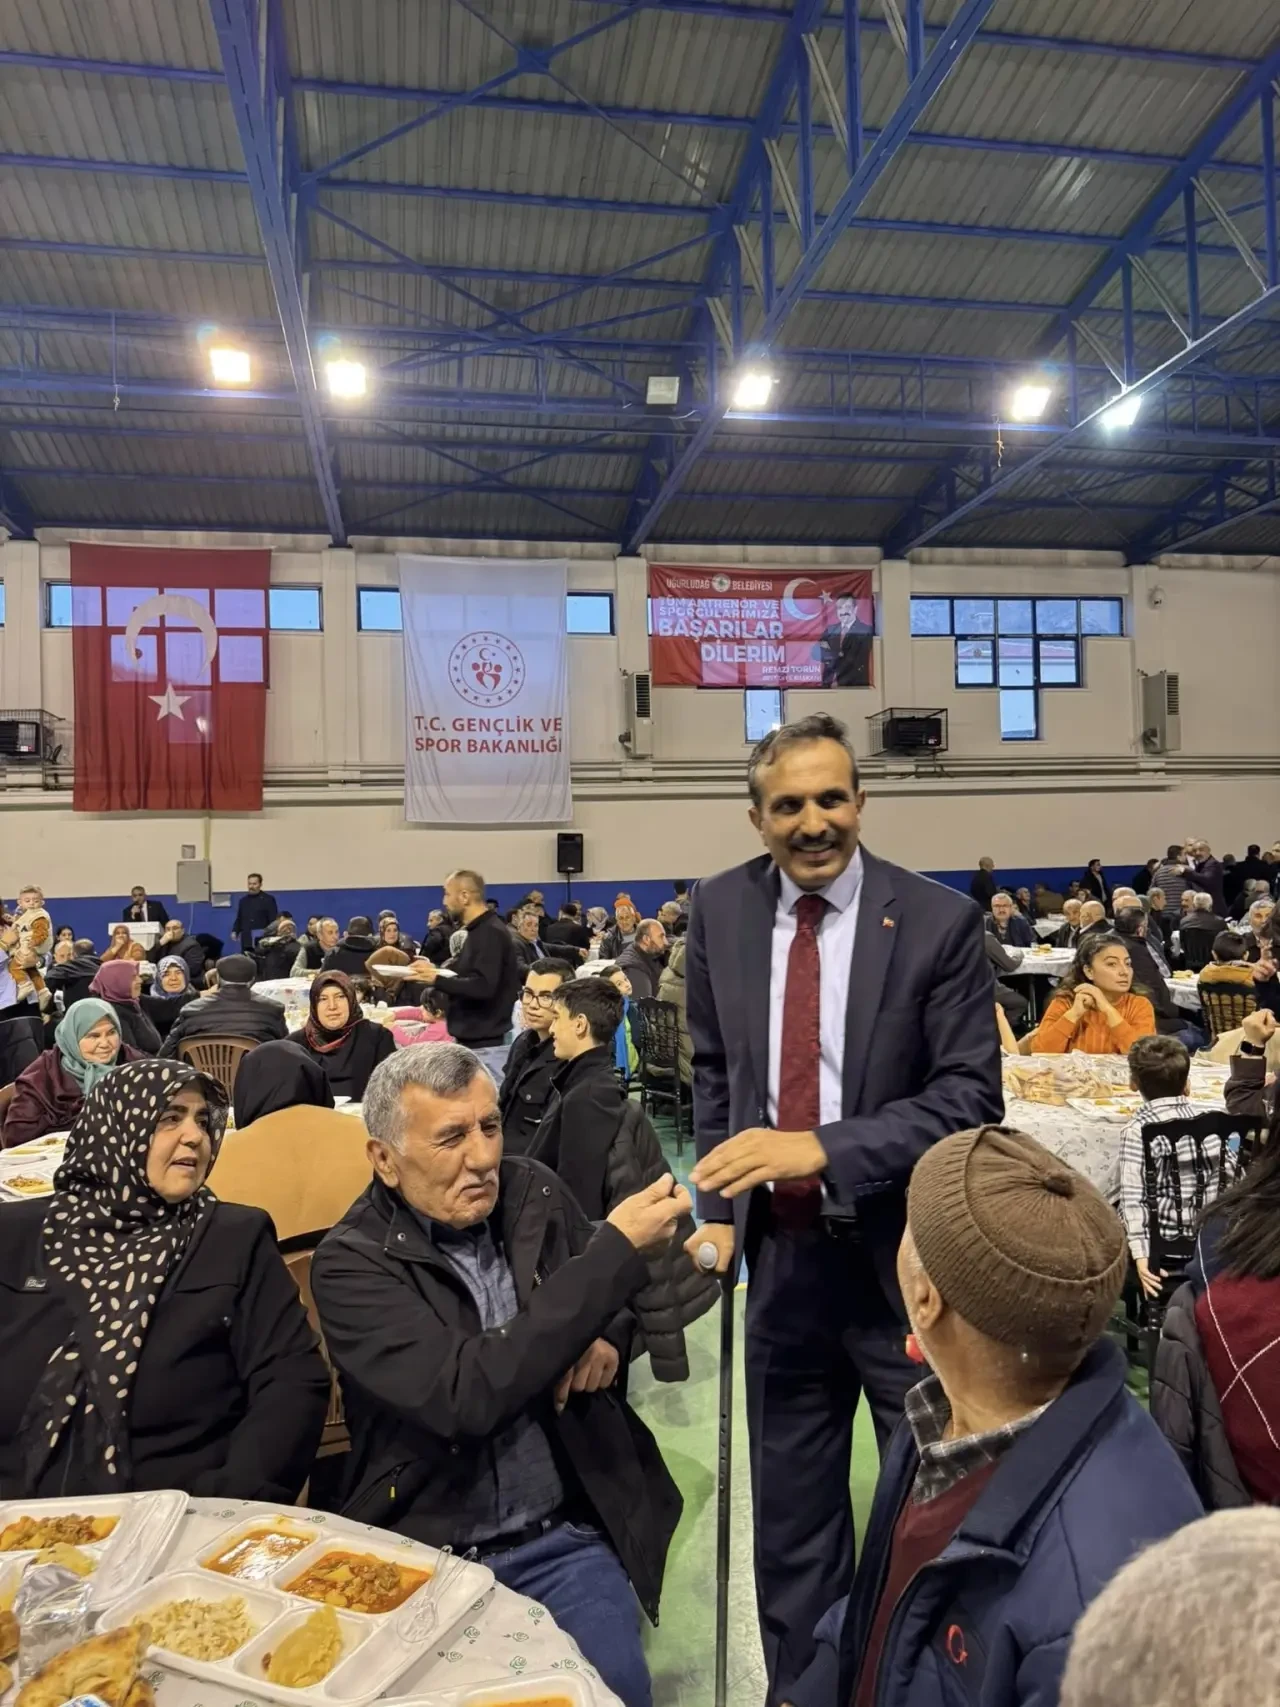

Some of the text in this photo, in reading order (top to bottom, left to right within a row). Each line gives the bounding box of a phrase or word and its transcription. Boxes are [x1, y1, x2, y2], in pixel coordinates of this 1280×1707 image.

[666, 577, 773, 591] UĞURLUDAĞ BELEDİYESİ
[688, 597, 757, 609] ANTRENÖR
[763, 599, 779, 609] VE
[659, 607, 779, 619] SPORCULARIMIZA
[659, 618, 783, 642] BAŞARILAR
[702, 640, 785, 663] DİLERİM
[791, 665, 820, 673] TORUN
[415, 715, 562, 736] T.C. GENÇLİK VE
[415, 737, 461, 753] SPOR
